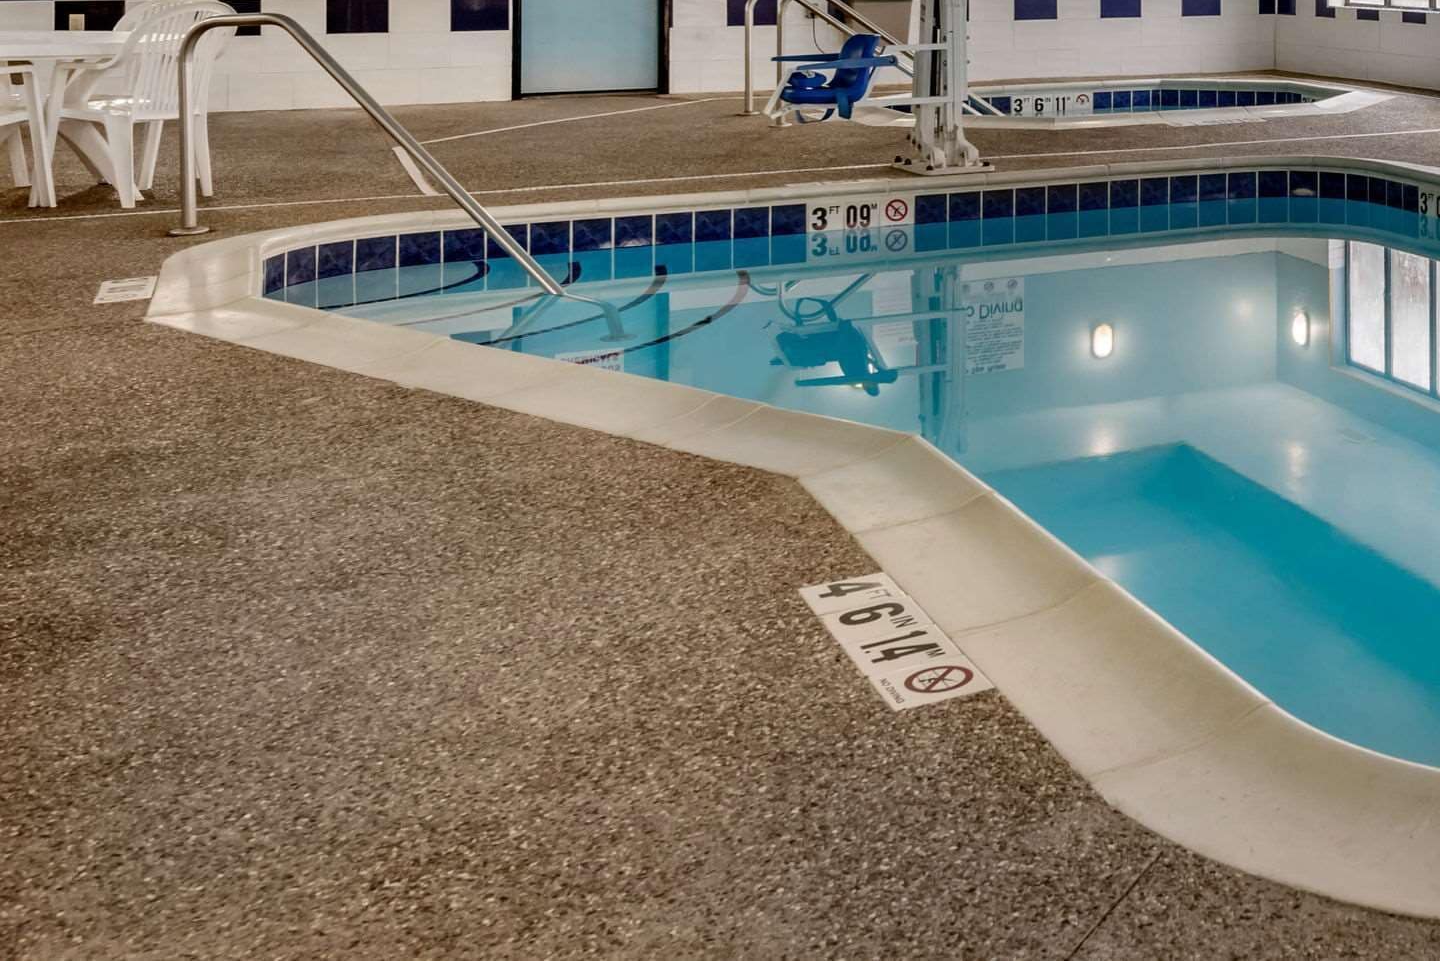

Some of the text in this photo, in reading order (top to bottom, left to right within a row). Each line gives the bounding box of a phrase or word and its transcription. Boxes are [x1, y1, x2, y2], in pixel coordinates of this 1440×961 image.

[1014, 98, 1023, 112] 3
[1034, 98, 1044, 112] 6
[1420, 192, 1428, 215] 3
[811, 207, 828, 231] 3
[819, 582, 882, 599] 4
[839, 602, 905, 626] 6
